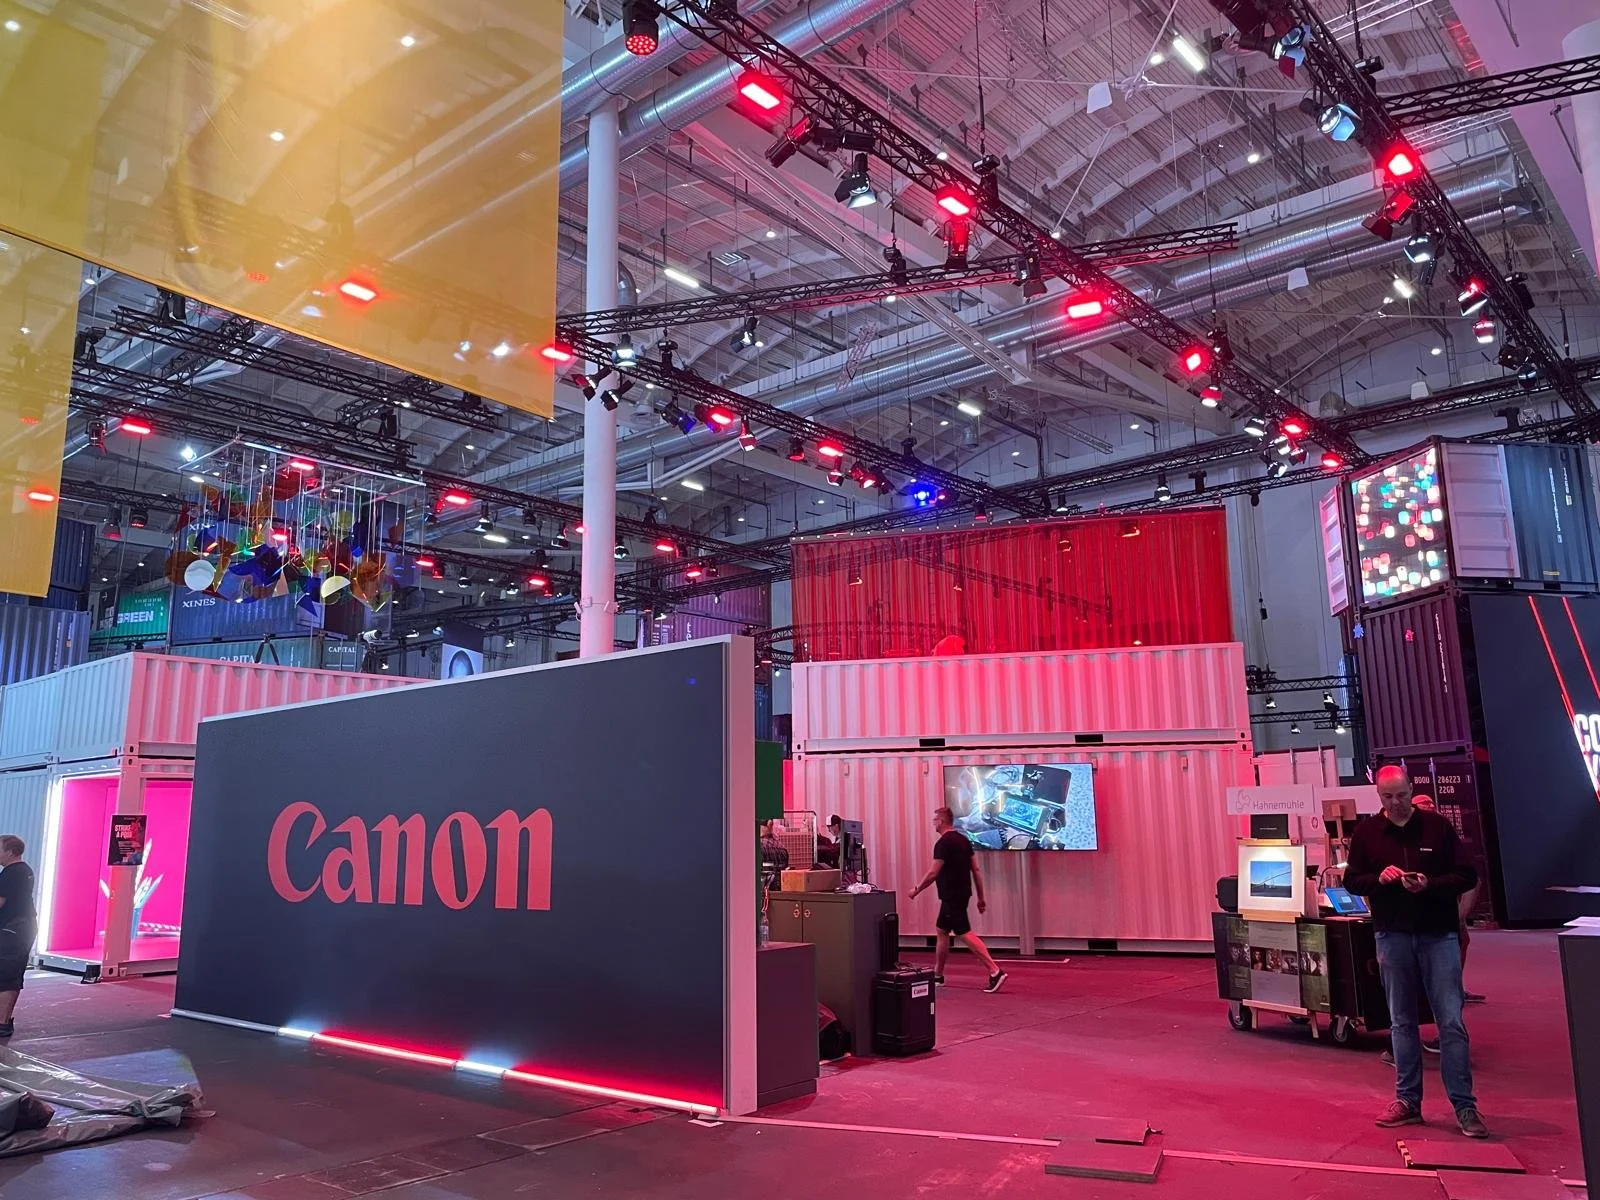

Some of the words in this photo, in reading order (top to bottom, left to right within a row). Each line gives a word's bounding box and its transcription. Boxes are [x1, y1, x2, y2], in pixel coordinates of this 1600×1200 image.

[182, 597, 216, 608] XINES
[1437, 775, 1461, 784] 286223
[267, 801, 553, 910] Canon
